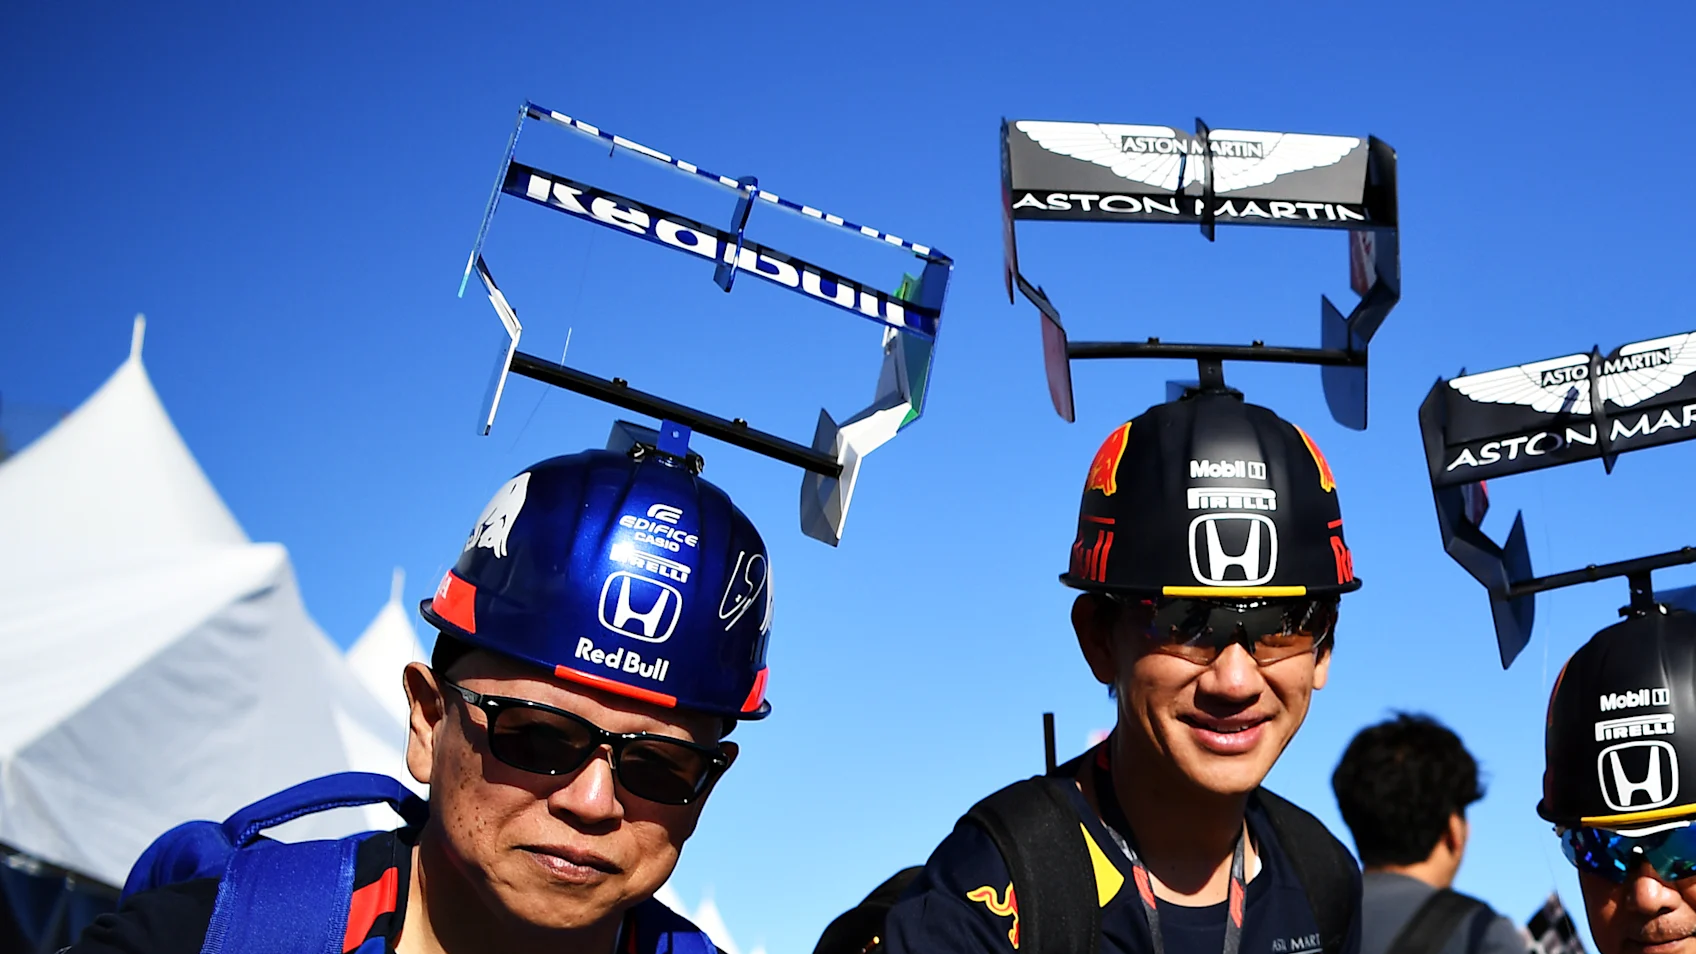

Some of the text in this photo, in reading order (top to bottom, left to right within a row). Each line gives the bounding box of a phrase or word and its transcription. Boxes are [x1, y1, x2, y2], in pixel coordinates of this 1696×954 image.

[1122, 136, 1188, 156] ASTON
[1012, 192, 1181, 215] ASTON
[1541, 347, 1672, 387] ASTO MARTIN
[1446, 423, 1599, 472] ASTON
[1190, 460, 1245, 478] Mobil
[1187, 488, 1277, 511] PIRELLI
[619, 514, 699, 548] EDIFICE
[634, 531, 681, 553] CASIO
[609, 543, 692, 584] PIRELLI
[574, 636, 670, 682] Red Bull
[1600, 689, 1650, 712] Mobil
[1595, 712, 1676, 742] PIRELLI
